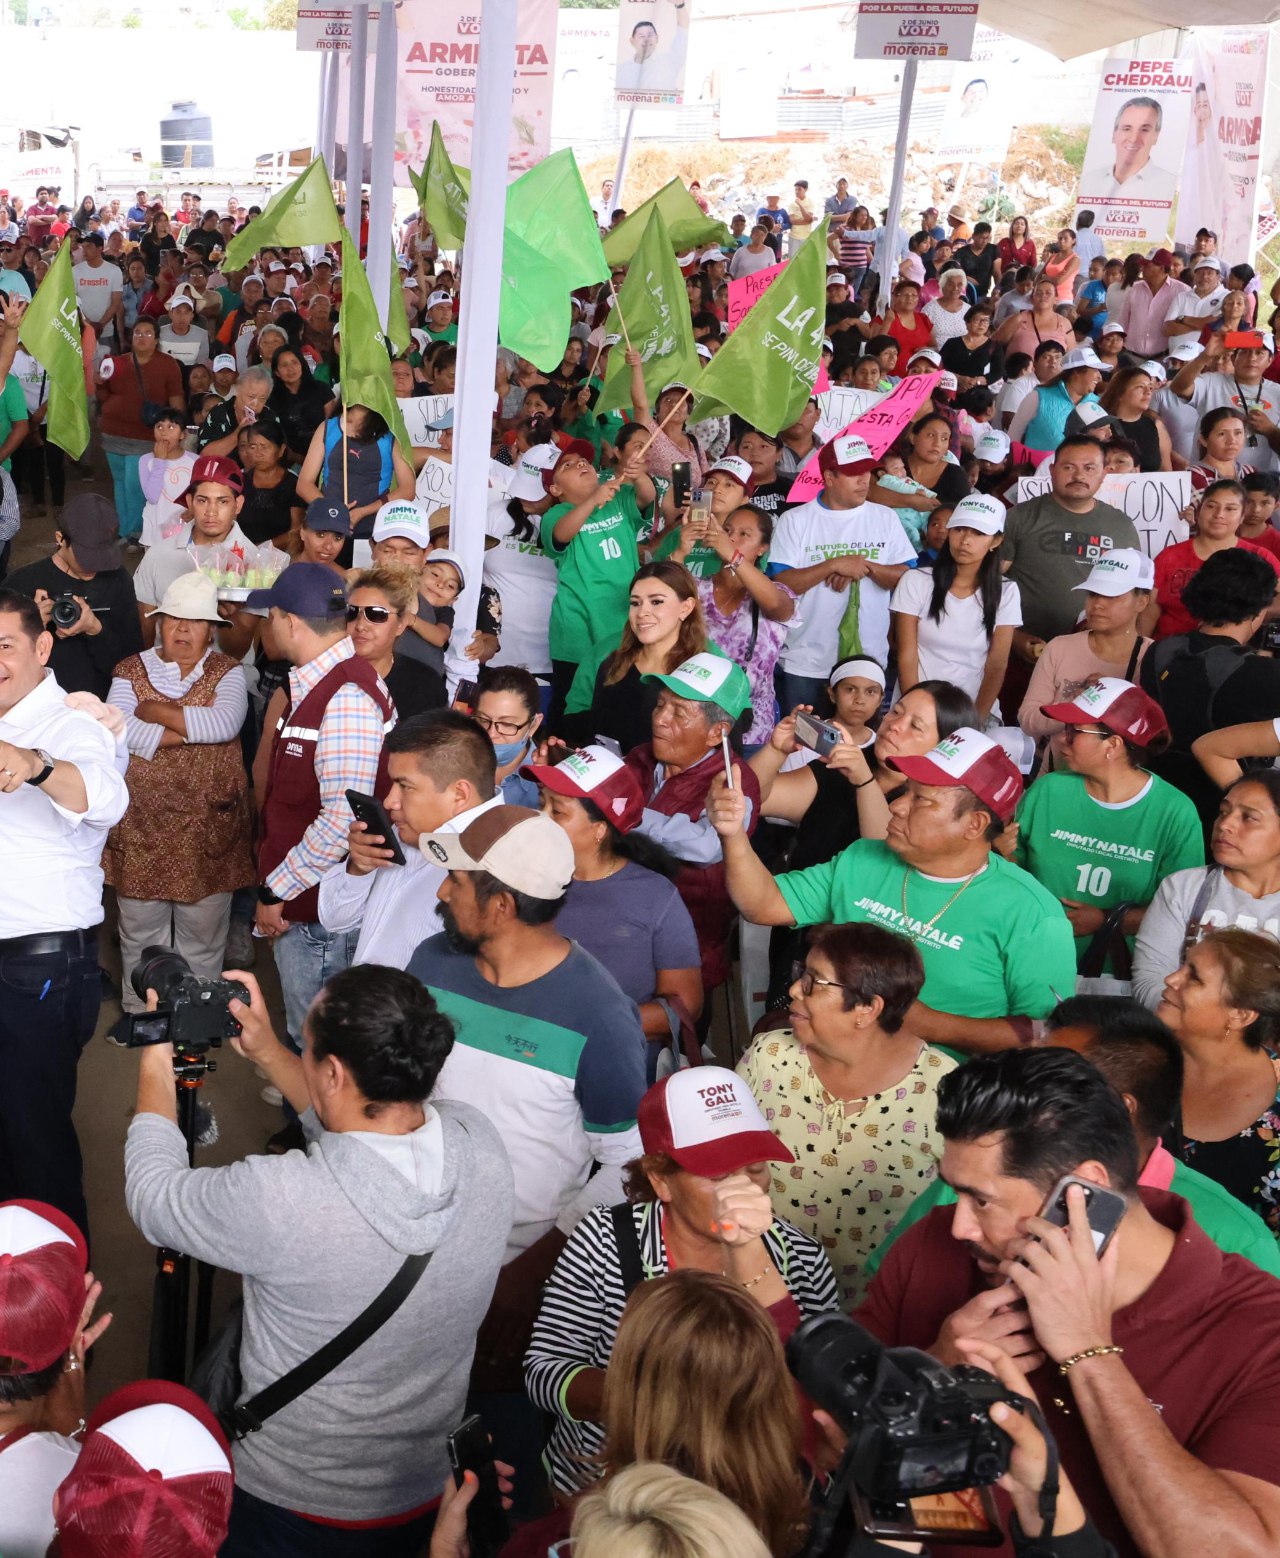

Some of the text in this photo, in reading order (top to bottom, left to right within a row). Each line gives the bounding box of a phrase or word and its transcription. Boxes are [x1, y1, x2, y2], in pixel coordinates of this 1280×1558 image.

[459, 23, 481, 34] VO
[900, 26, 939, 36] VOTA
[883, 45, 936, 56] morena
[1129, 61, 1174, 73] PEPE
[437, 94, 464, 102] AMOR
[617, 94, 652, 103] morena
[937, 148, 973, 156] morena
[1107, 213, 1139, 223] VOTA
[1094, 227, 1136, 237] morena
[79, 278, 108, 287] CrossFit
[59, 298, 77, 327] LA
[776, 296, 816, 335] LA
[50, 318, 79, 353] SE PINTA
[762, 332, 777, 347] SE
[388, 507, 418, 516] JIMMY
[959, 500, 996, 514] TONY GALI
[385, 514, 420, 523] NATALE
[599, 538, 622, 560] 10
[815, 543, 849, 552] FUTURO
[1109, 560, 1129, 570] GALI
[1066, 842, 1139, 864] DIPUTADO LOCAL DISTRITO
[1076, 863, 1112, 898] 10
[866, 912, 895, 929] DIPUTADO
[697, 1083, 733, 1099] TONY
[705, 1093, 737, 1107] GALI
[712, 1112, 735, 1121] morena
